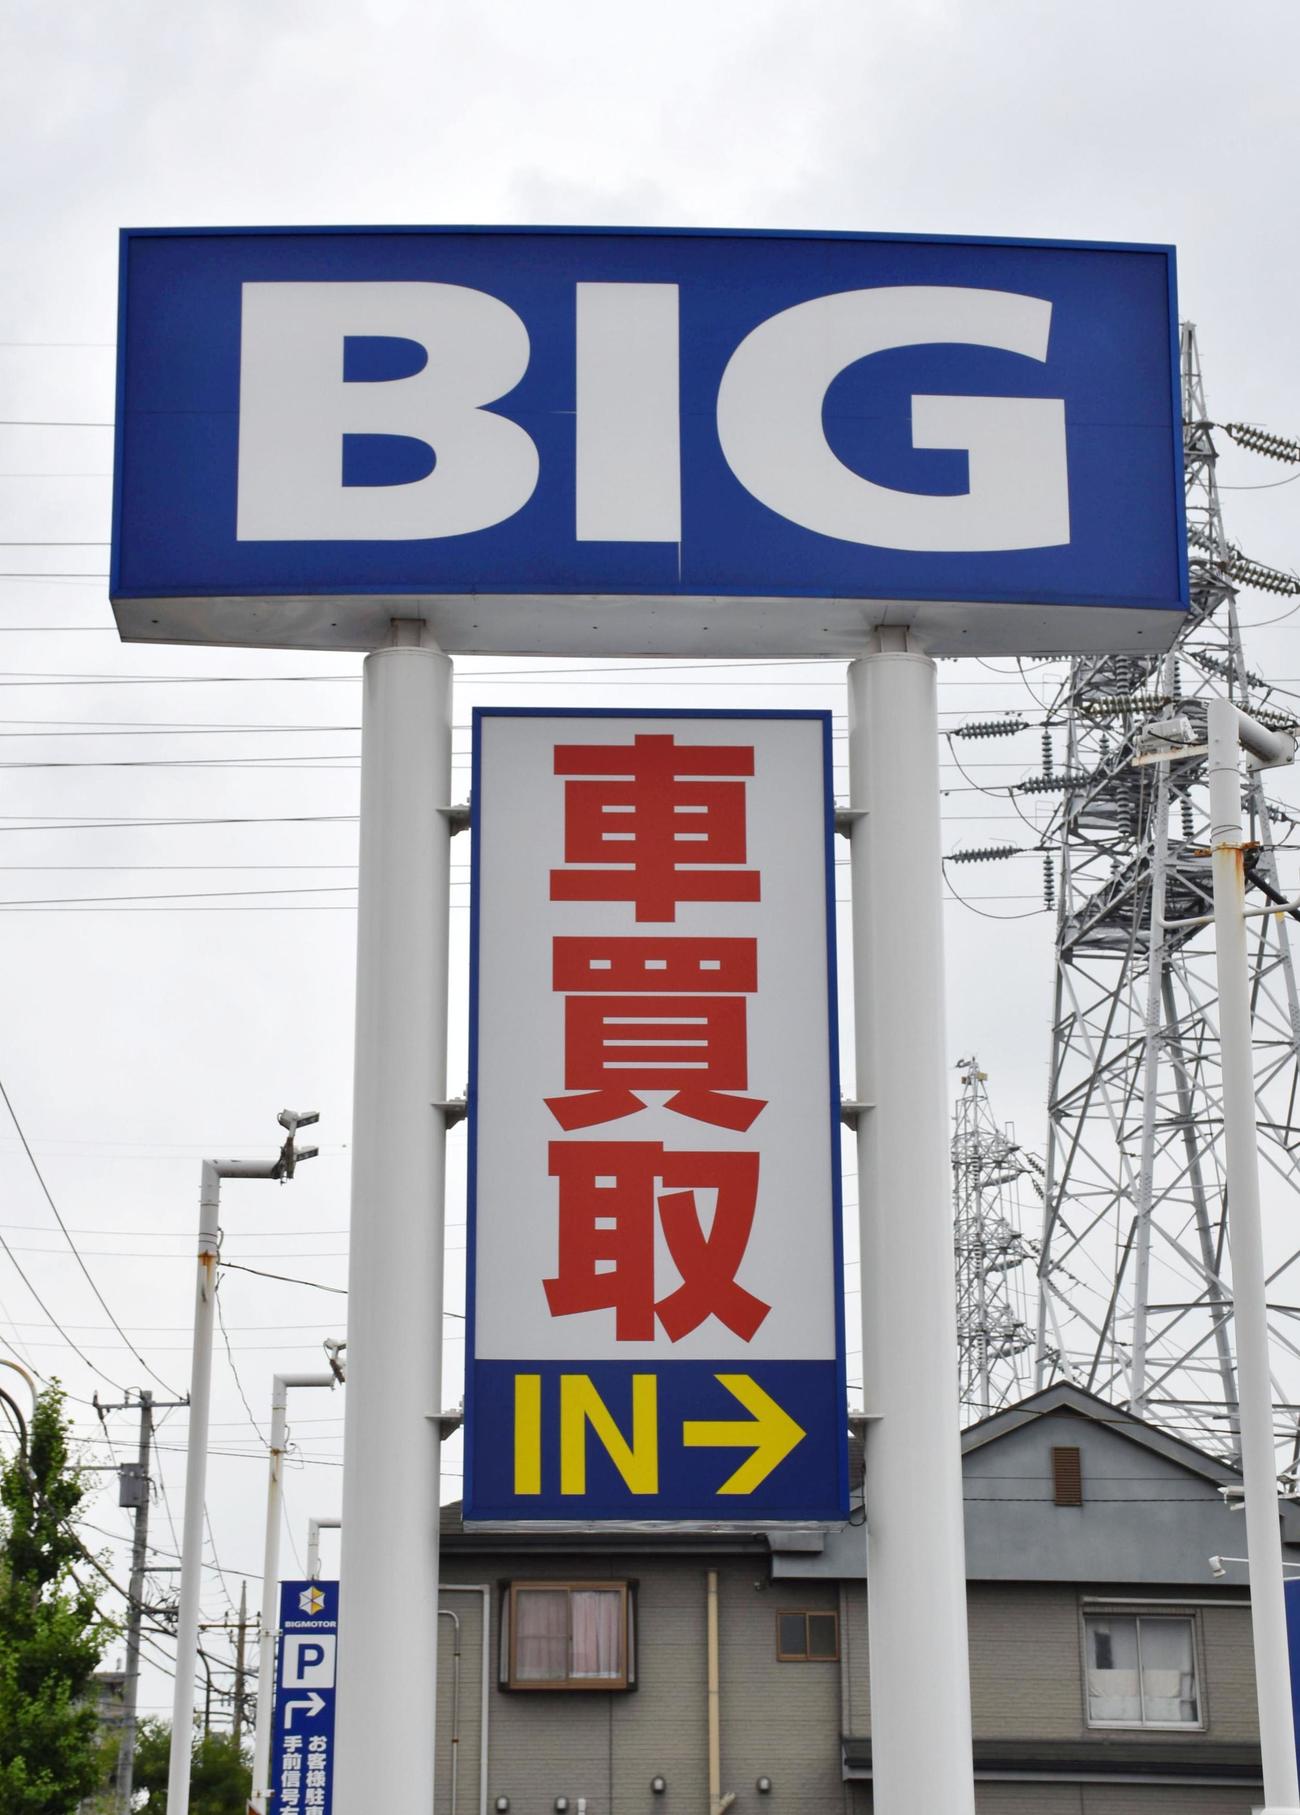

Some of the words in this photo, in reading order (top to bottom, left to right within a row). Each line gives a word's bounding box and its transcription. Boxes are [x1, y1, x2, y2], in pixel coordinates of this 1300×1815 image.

[236, 281, 1071, 552] BIG
[543, 734, 771, 1343] 車買取
[513, 1373, 659, 1496] IN
[297, 1643, 324, 1680] P
